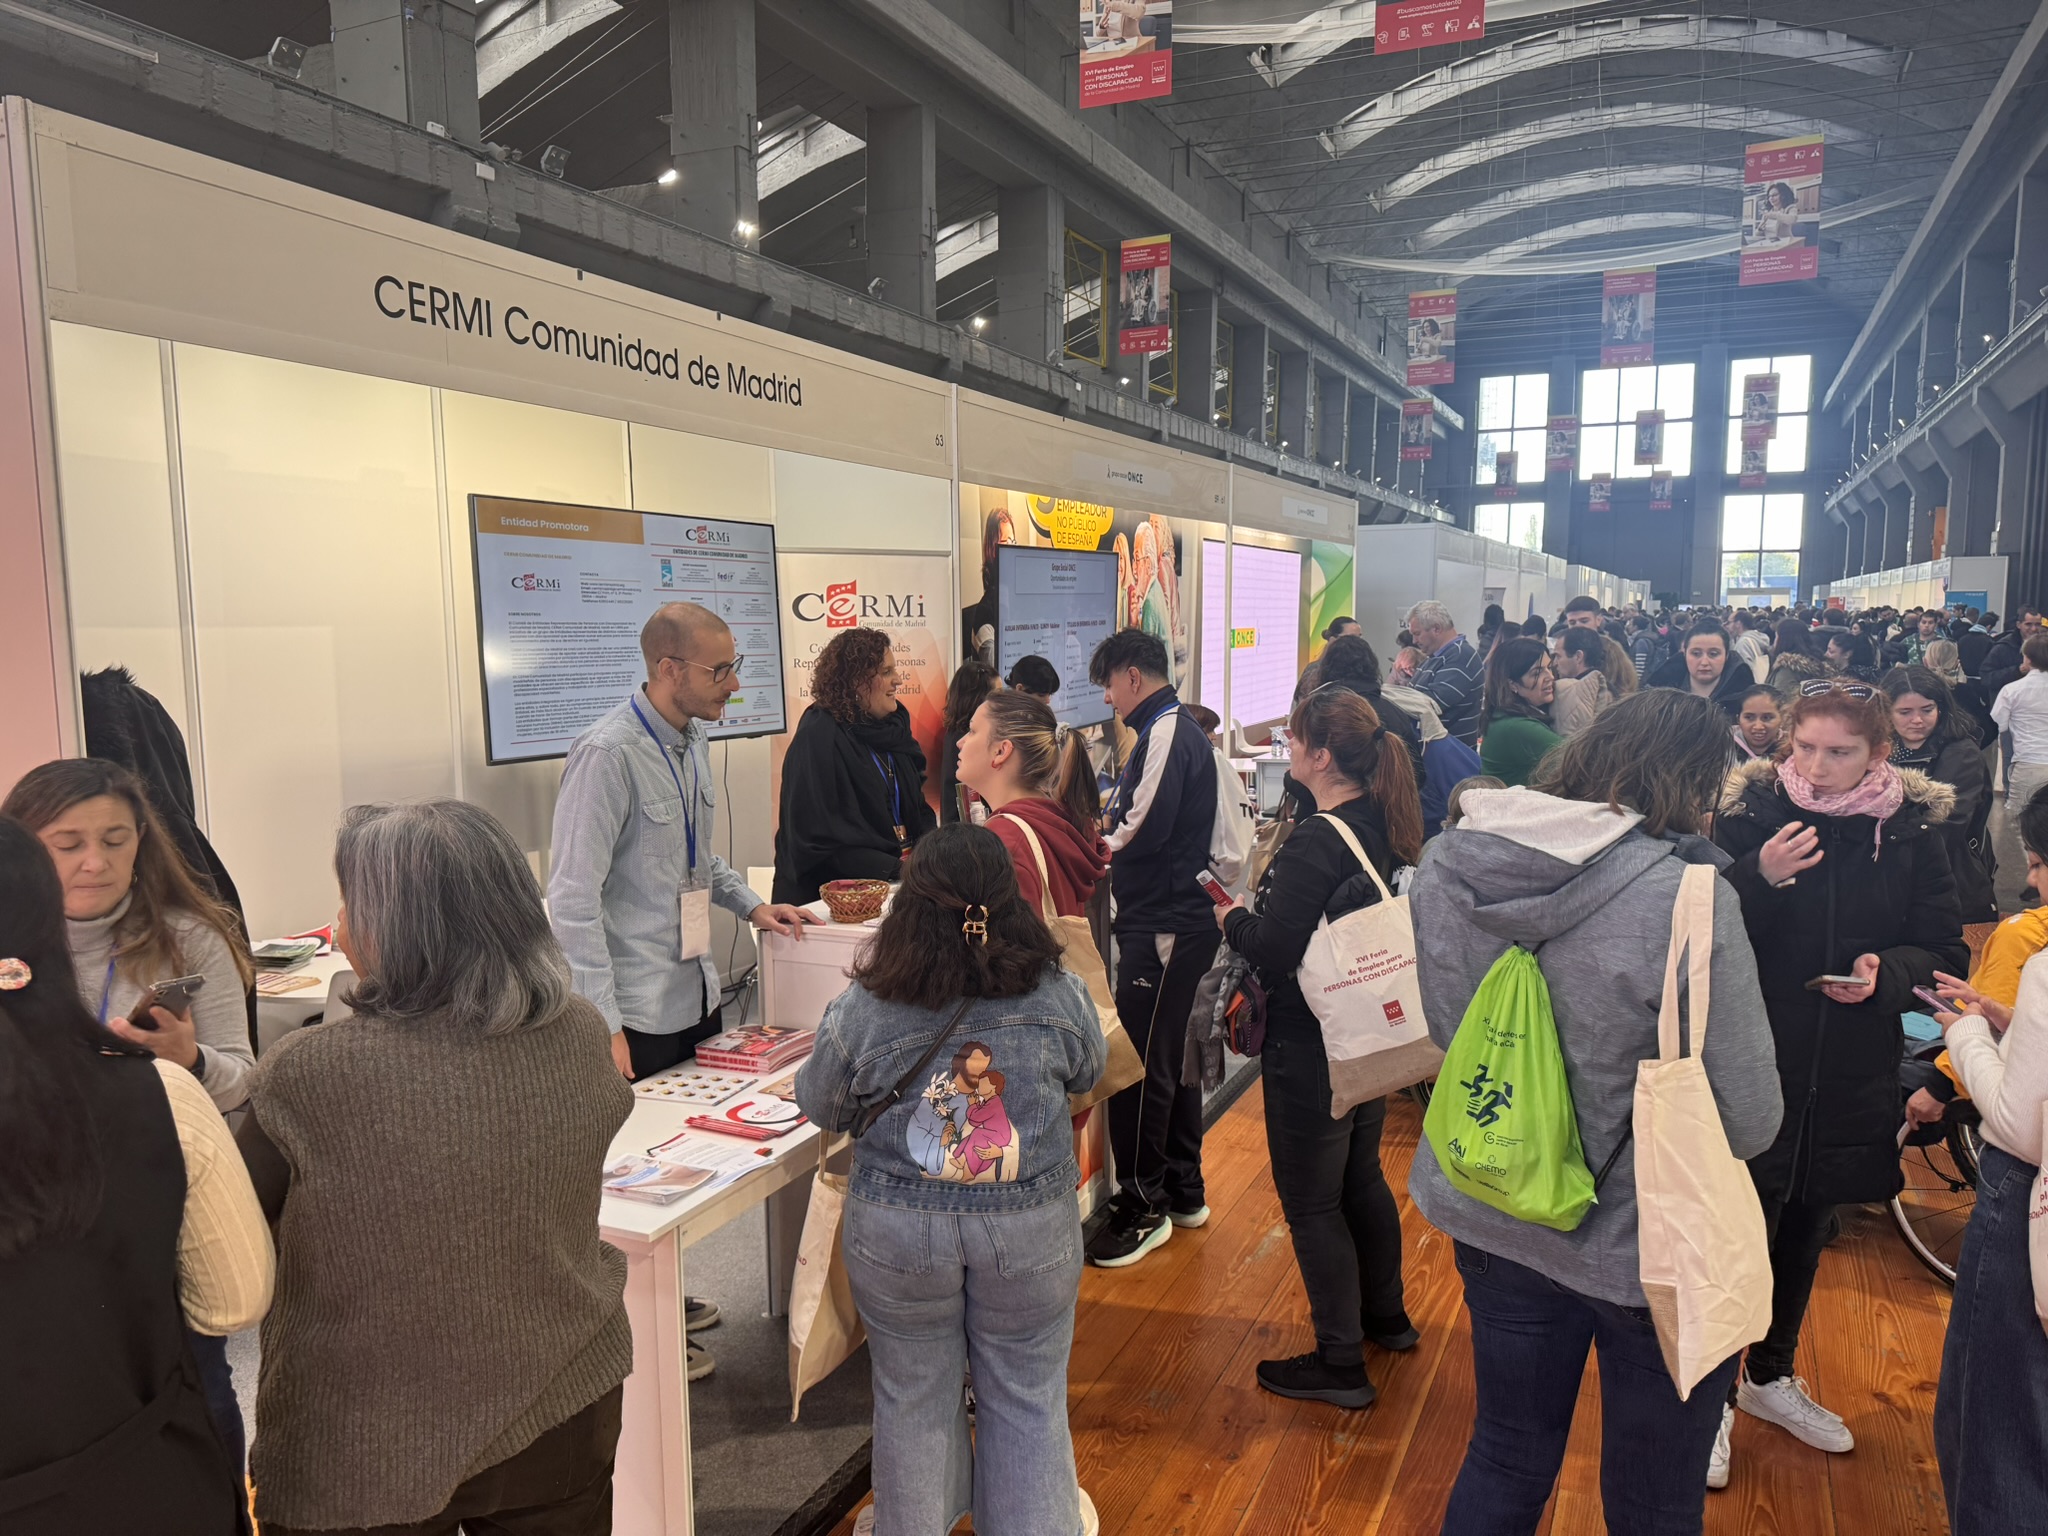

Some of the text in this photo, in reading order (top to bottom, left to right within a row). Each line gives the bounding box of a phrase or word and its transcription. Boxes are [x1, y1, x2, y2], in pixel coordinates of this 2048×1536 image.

[1096, 71, 1128, 81] PERSONAS
[1099, 76, 1143, 88] DISCAPACIDAD
[1756, 263, 1794, 272] DISCAPACIDAD
[374, 275, 802, 406] CERMI Comunidad de Madrid
[935, 433, 944, 447] 63
[1128, 471, 1143, 484] ONCE
[1057, 500, 1107, 518] EMPLEADOR
[501, 516, 589, 532] Entidad Promotora
[1057, 515, 1097, 532] NO PÚBLICO
[1057, 531, 1094, 547] DE ESPAÑA
[858, 619, 926, 628] Comunidad de Madrid
[1236, 630, 1254, 645] ONCE
[895, 656, 926, 667] rsonas
[799, 687, 809, 697] la
[894, 684, 921, 695] adrid
[1355, 948, 1388, 964] XVI Feria
[1347, 953, 1403, 977] de Empleo para
[1323, 976, 1363, 994] PERSONAS
[1363, 971, 1381, 983] CON
[1475, 1161, 1507, 1176] CHEMO
